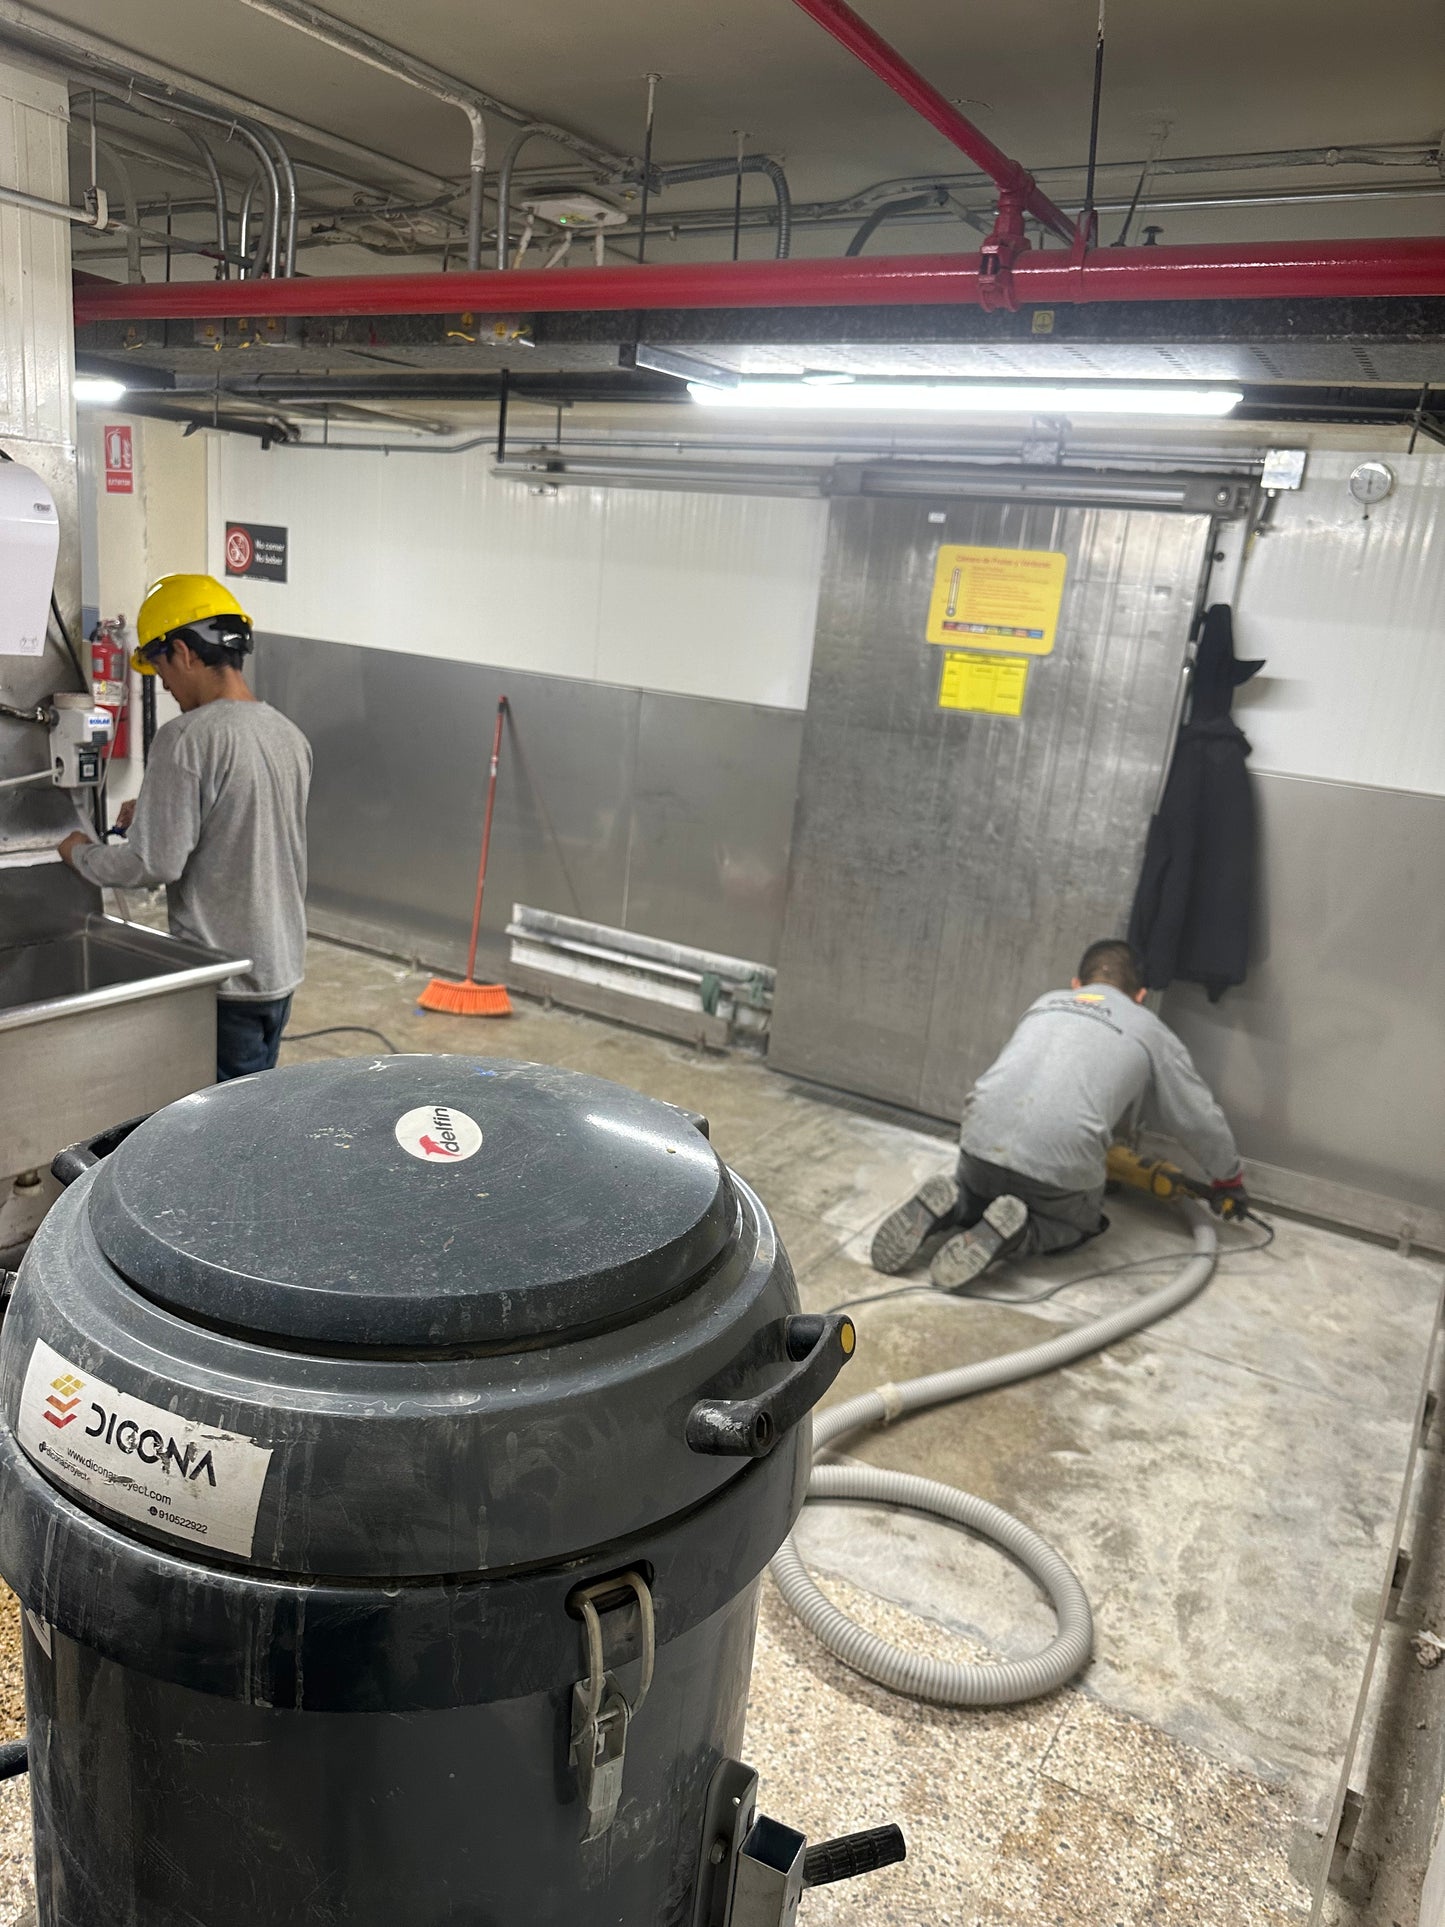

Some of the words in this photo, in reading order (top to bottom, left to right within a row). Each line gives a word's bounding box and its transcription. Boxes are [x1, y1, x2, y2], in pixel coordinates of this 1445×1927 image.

[255, 538, 264, 550] No
[255, 553, 264, 563] No
[433, 1108, 460, 1153] delfin
[85, 1402, 217, 1487] DICONA
[67, 1447, 171, 1506] www.diconayect.com
[158, 1509, 208, 1534] 910522922
